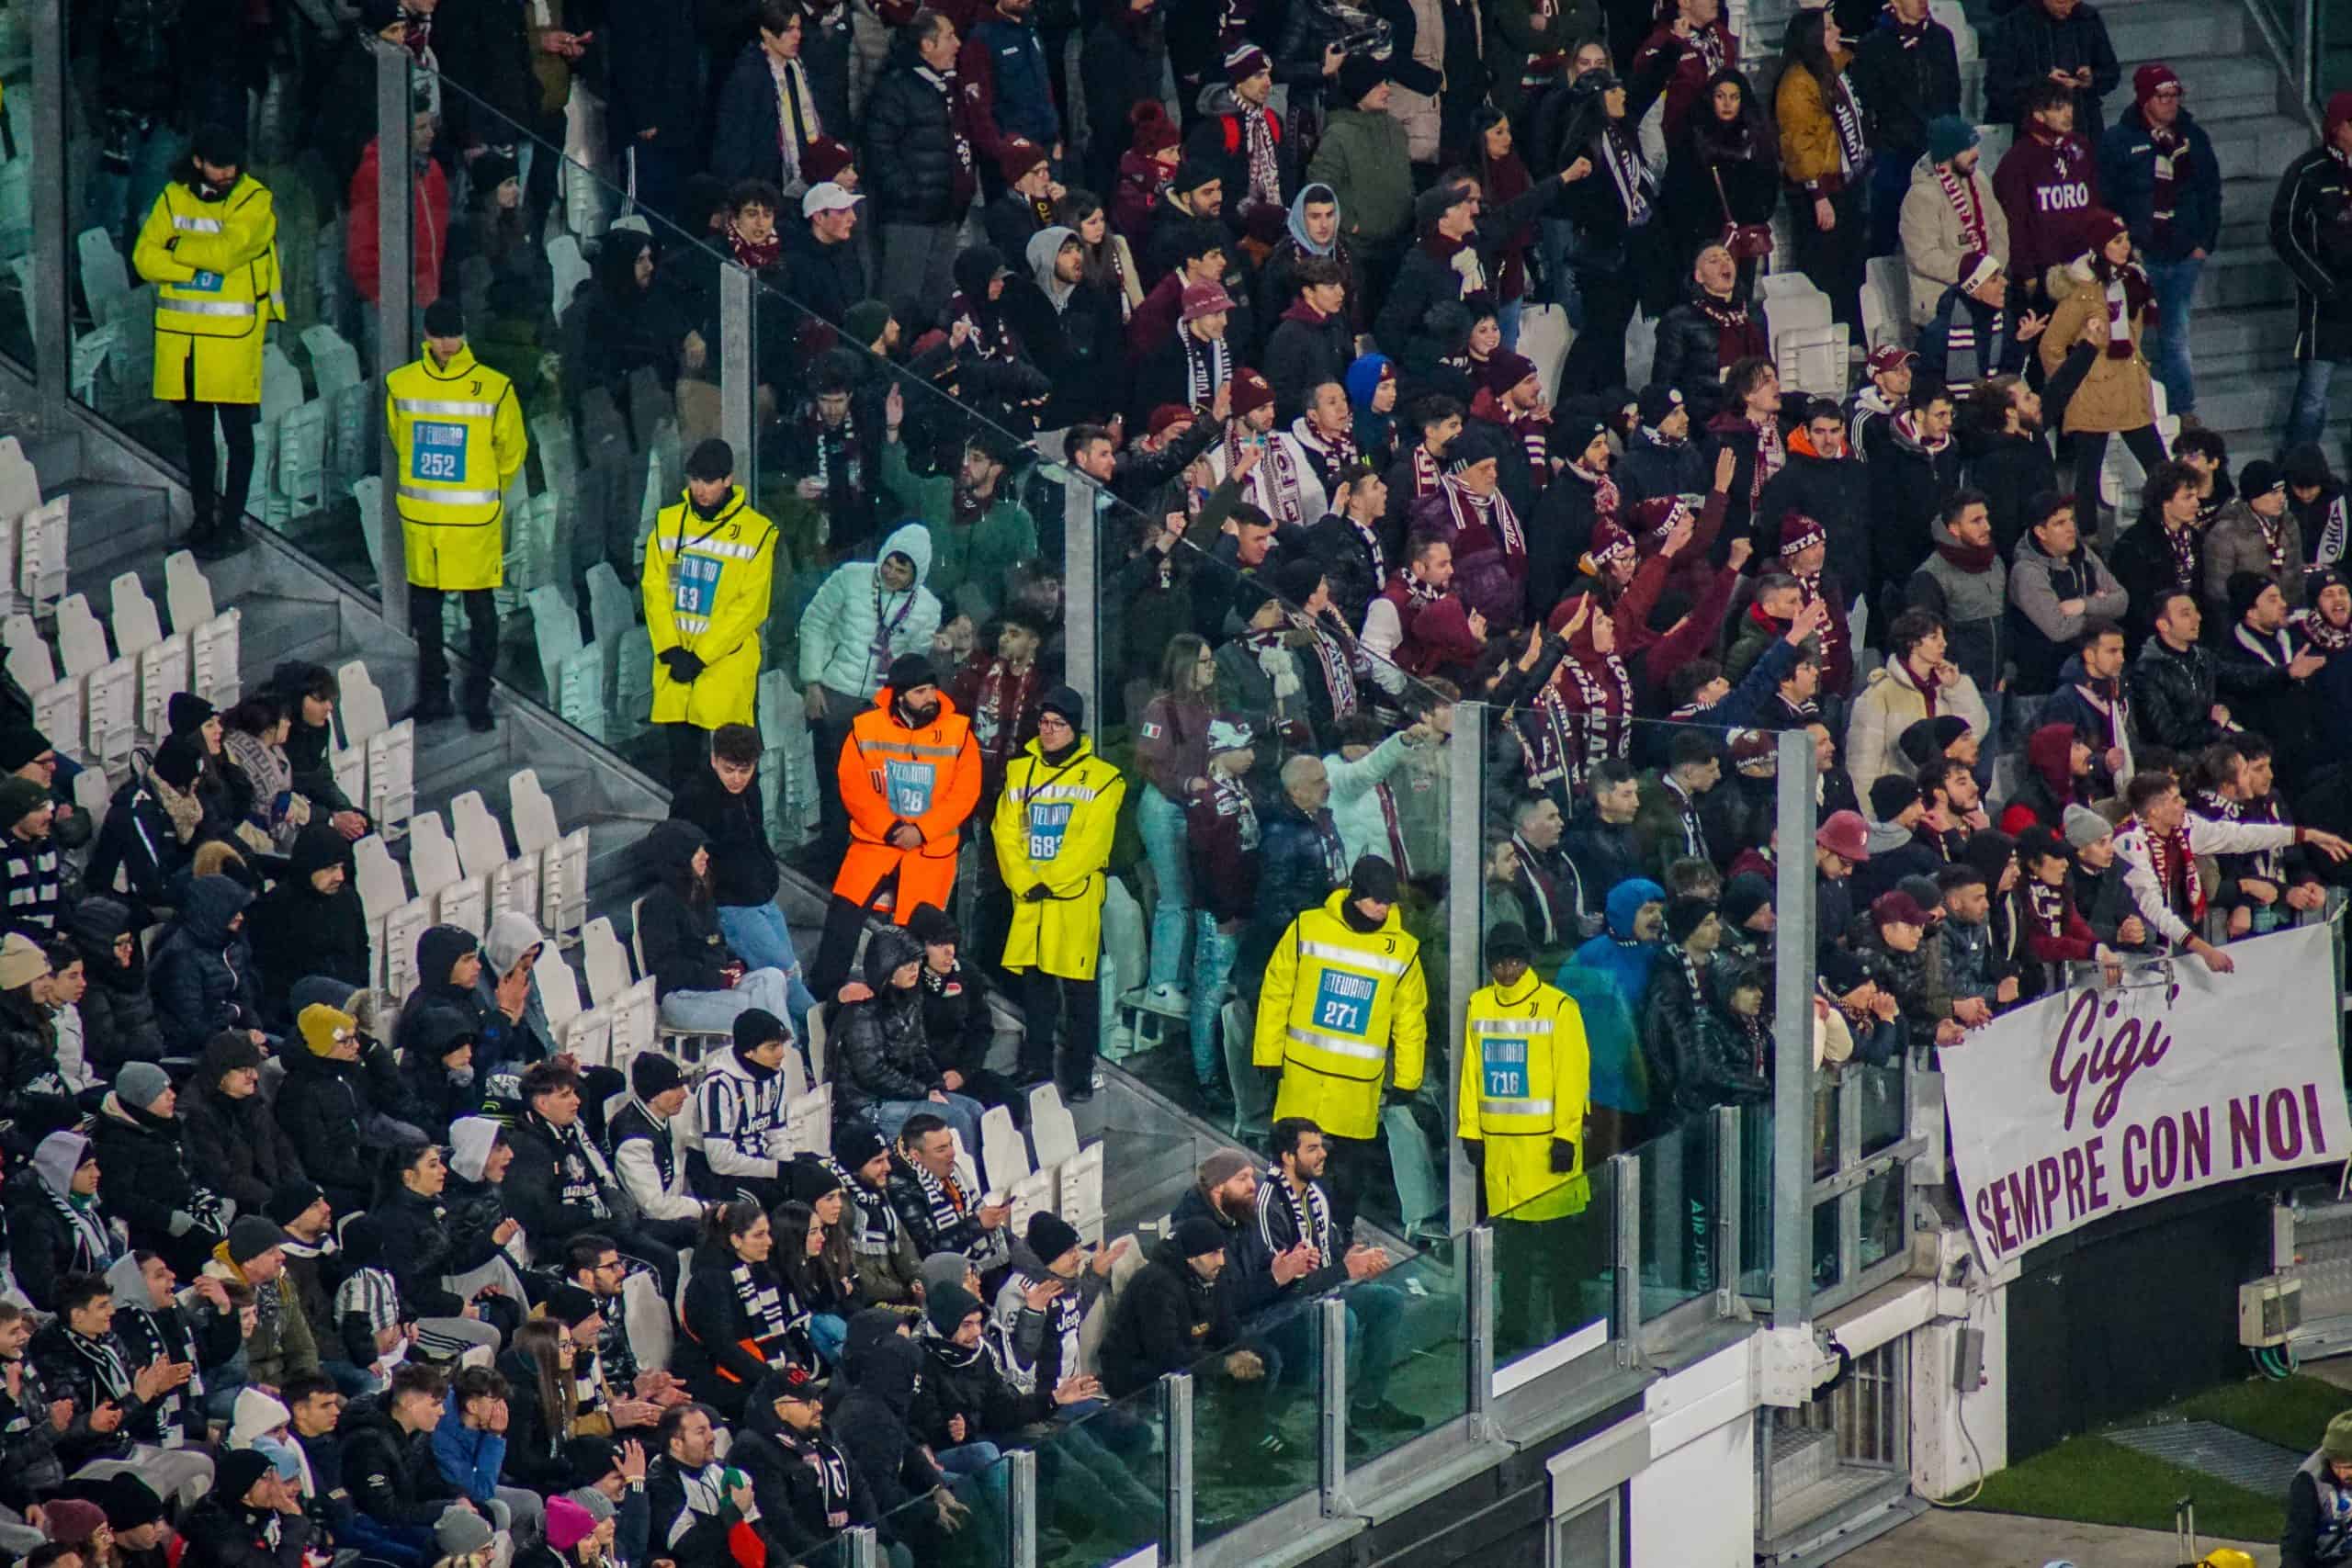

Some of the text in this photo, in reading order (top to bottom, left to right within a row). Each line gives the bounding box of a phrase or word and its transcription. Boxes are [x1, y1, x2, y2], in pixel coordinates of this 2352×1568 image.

[2037, 181, 2089, 211] TORO
[421, 452, 456, 477] 252
[1324, 971, 1374, 1000] STEWARD
[1324, 999, 1358, 1029] 271
[2049, 983, 2180, 1131] Gigi
[1490, 1071, 1520, 1095] 716
[1975, 1082, 2326, 1260] SEMPRE CON NOI
